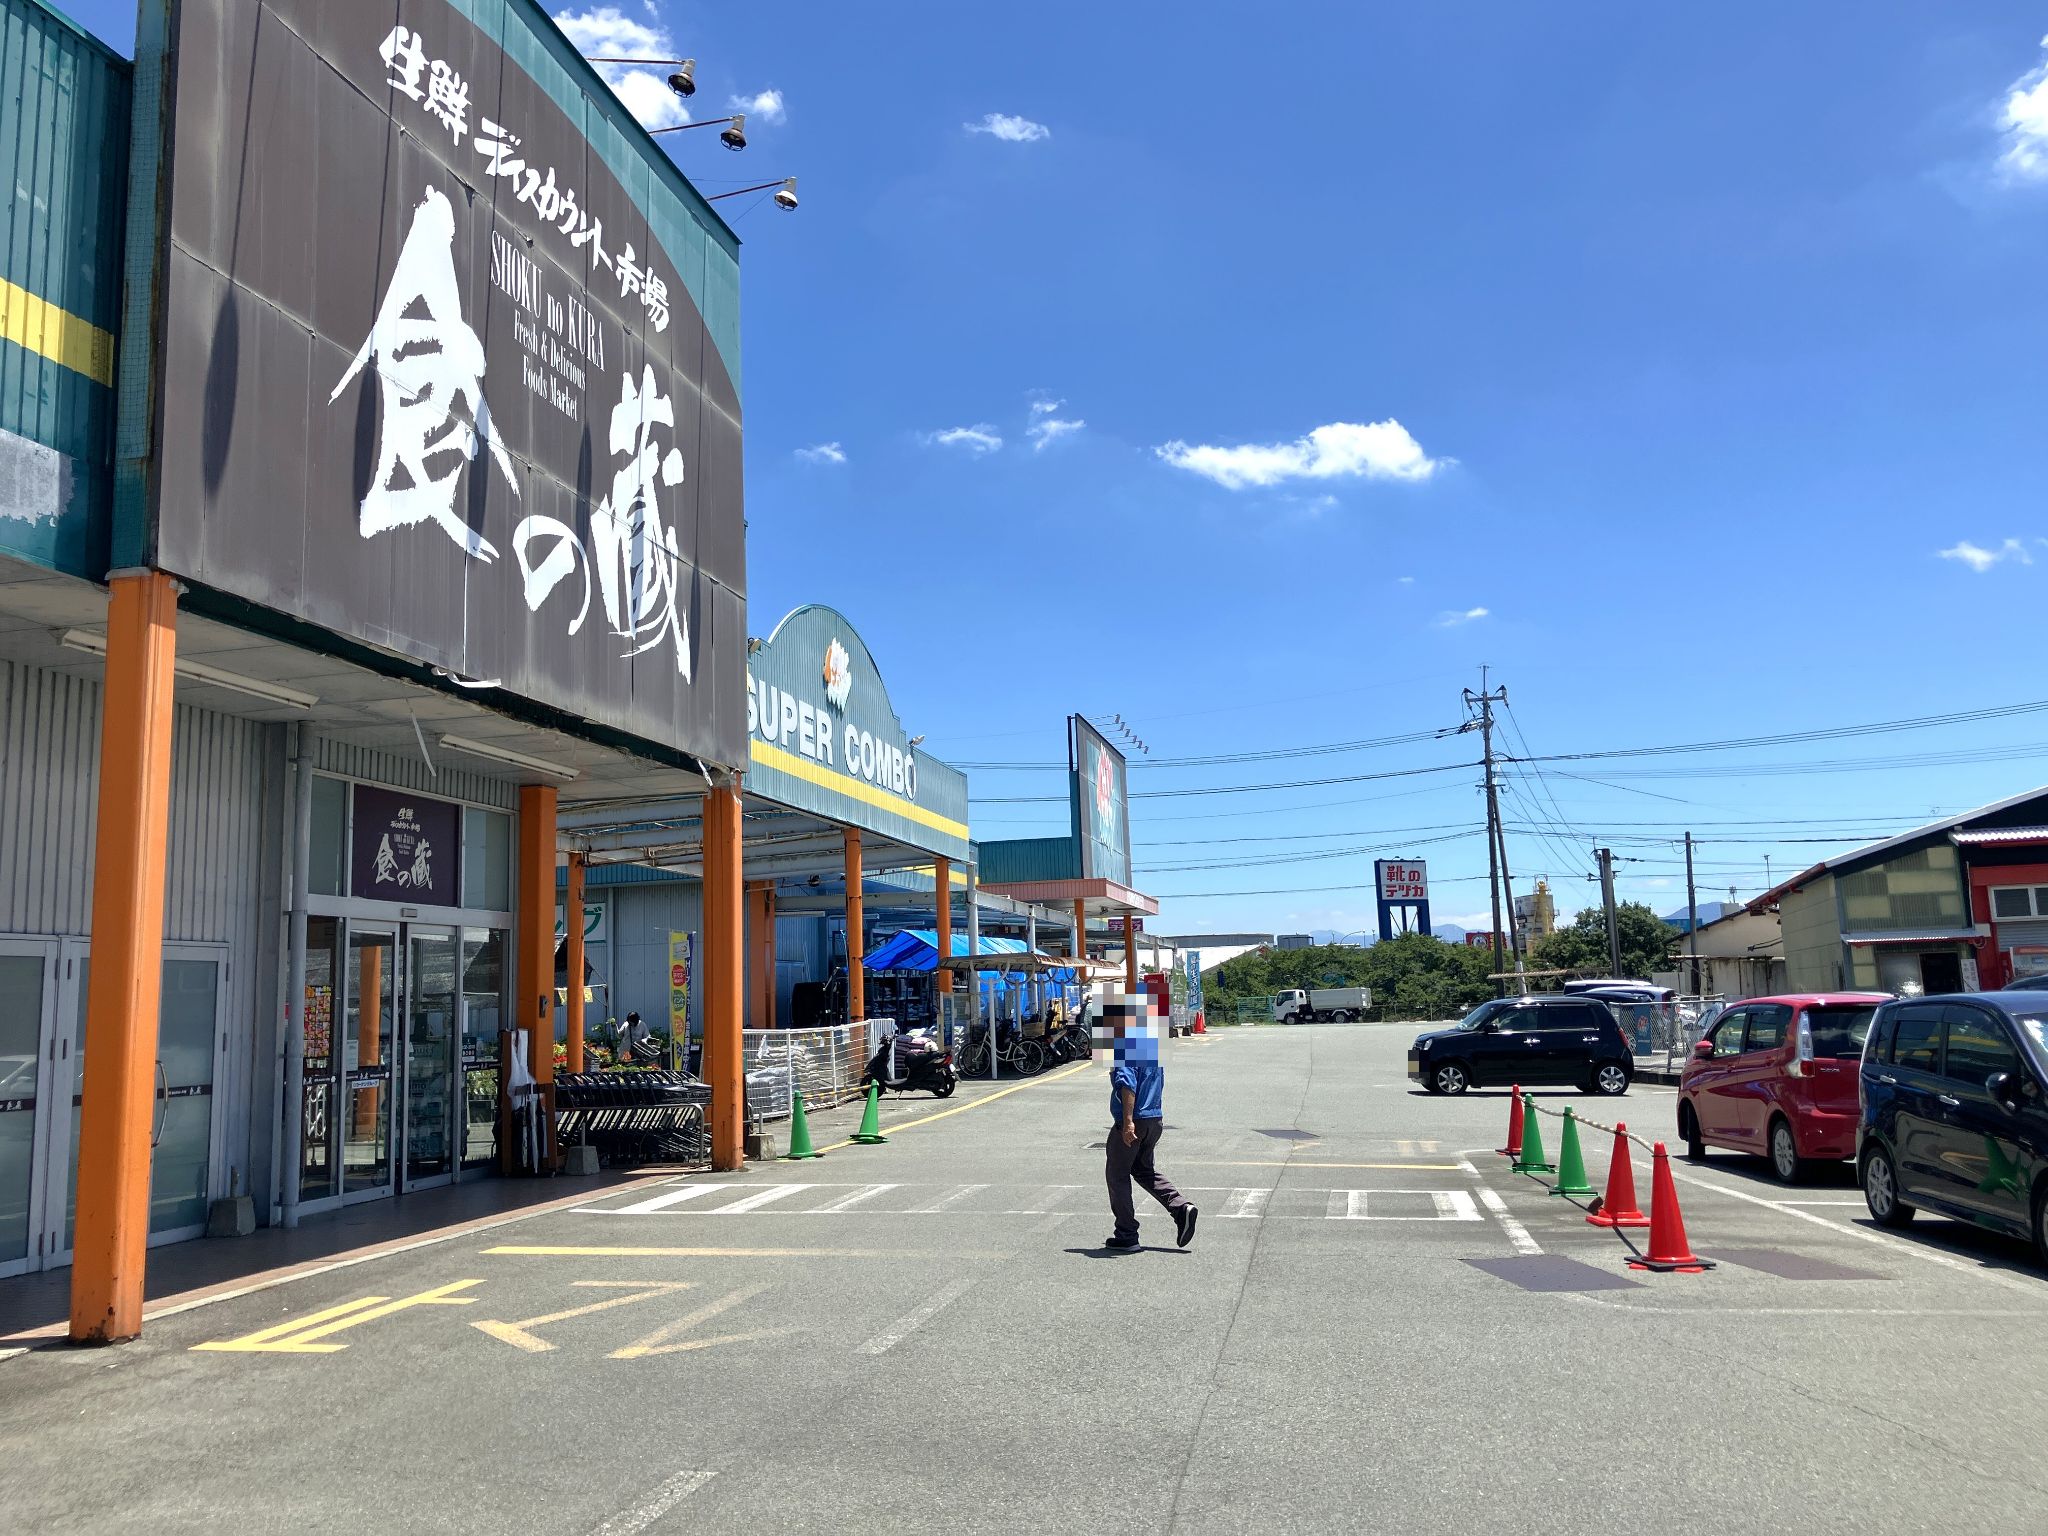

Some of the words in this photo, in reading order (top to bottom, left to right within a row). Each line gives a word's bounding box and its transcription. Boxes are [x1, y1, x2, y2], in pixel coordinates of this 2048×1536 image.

[379, 25, 472, 146] 生鮮
[473, 117, 613, 270] ディスカウント
[616, 243, 670, 332] 市場
[490, 230, 543, 319] SHOKU
[547, 292, 564, 337] no
[568, 294, 605, 372] KURA
[514, 308, 538, 356] Fresh
[541, 330, 548, 363] &
[550, 336, 586, 392] Delicious
[522, 353, 548, 400] Foods
[549, 373, 578, 422] Market
[328, 185, 691, 685] 食の蔵
[747, 672, 833, 766] SUPER
[844, 723, 917, 800] COMBO
[371, 833, 433, 890] 食の蔵
[1385, 884, 1424, 898] テヅカ
[1386, 865, 1421, 882] 靴の
